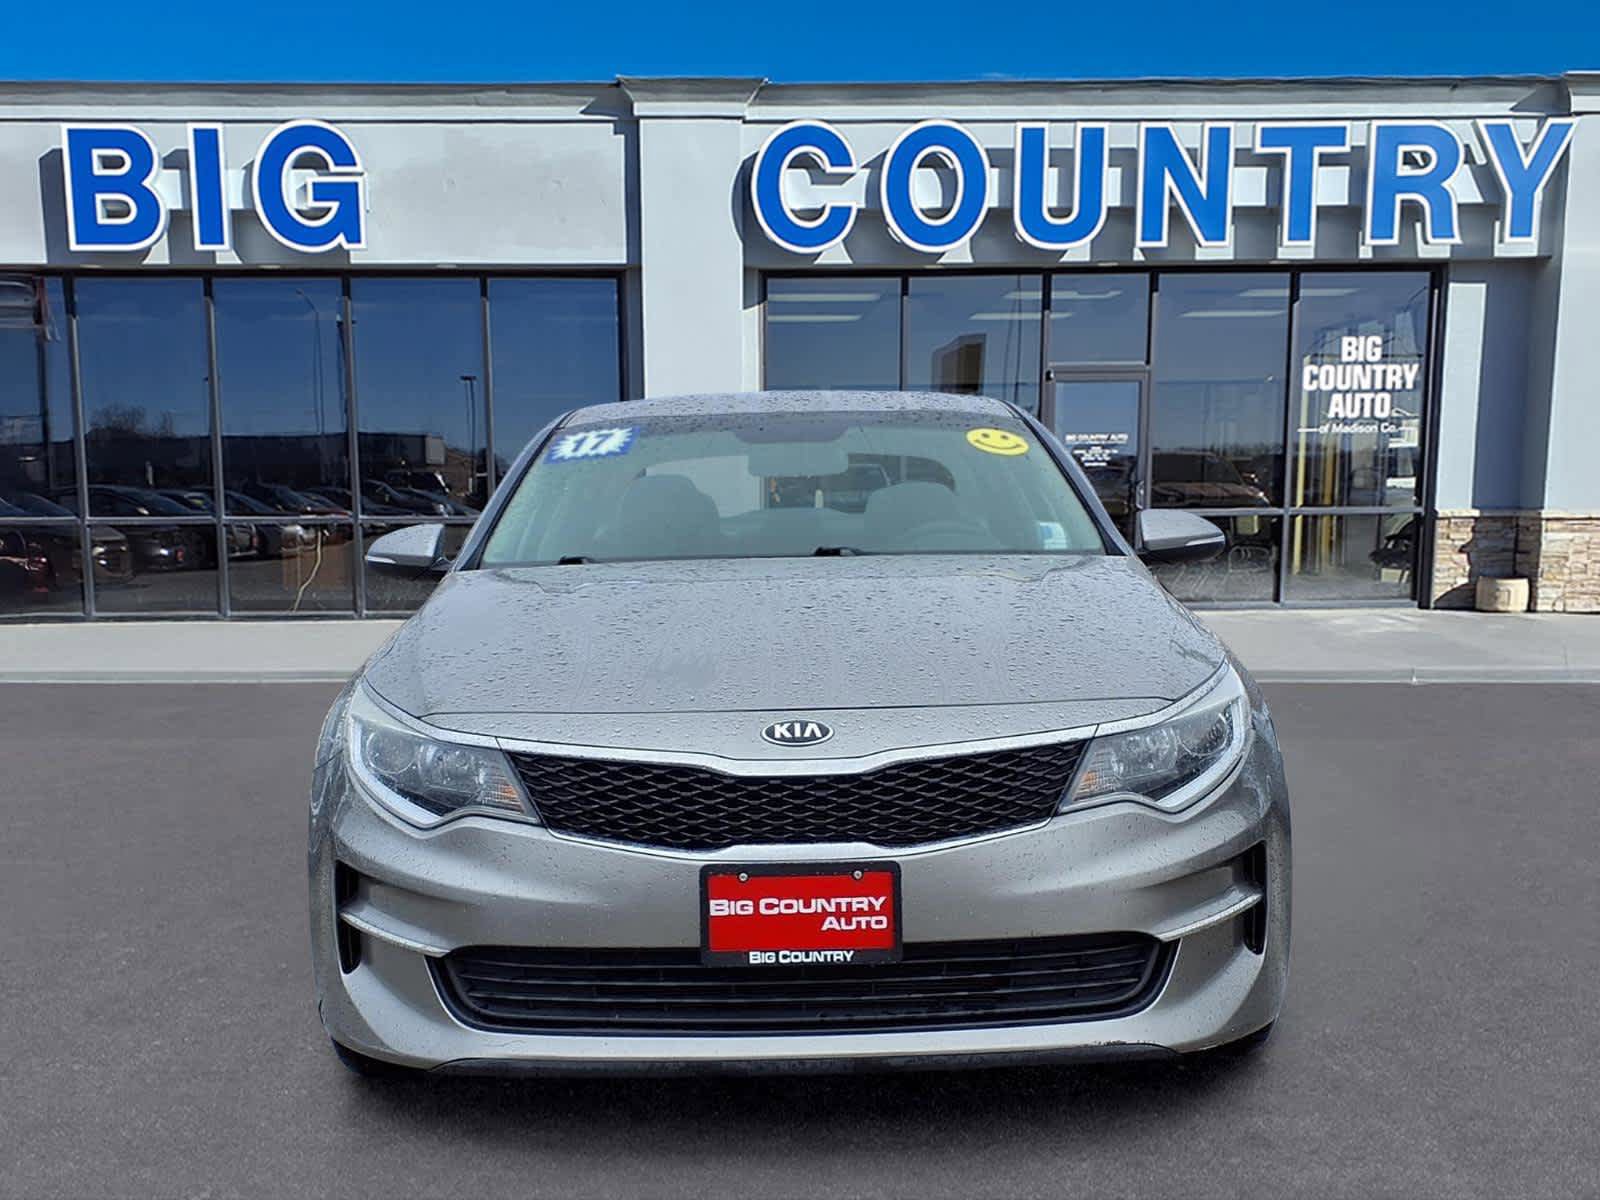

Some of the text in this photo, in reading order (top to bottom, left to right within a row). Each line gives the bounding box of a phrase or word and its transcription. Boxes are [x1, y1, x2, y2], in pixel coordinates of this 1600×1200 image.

[61, 118, 1575, 255] BIG COUNTRY
[1341, 335, 1382, 362] BIG
[1303, 363, 1419, 391] COUNTRY
[1327, 392, 1392, 419] AUTO
[571, 431, 615, 454] 17
[774, 722, 823, 738] KIA
[709, 896, 887, 916] BIG COUNTRY
[821, 915, 888, 931] AUTO
[749, 950, 854, 964] BIG COUNTRY
